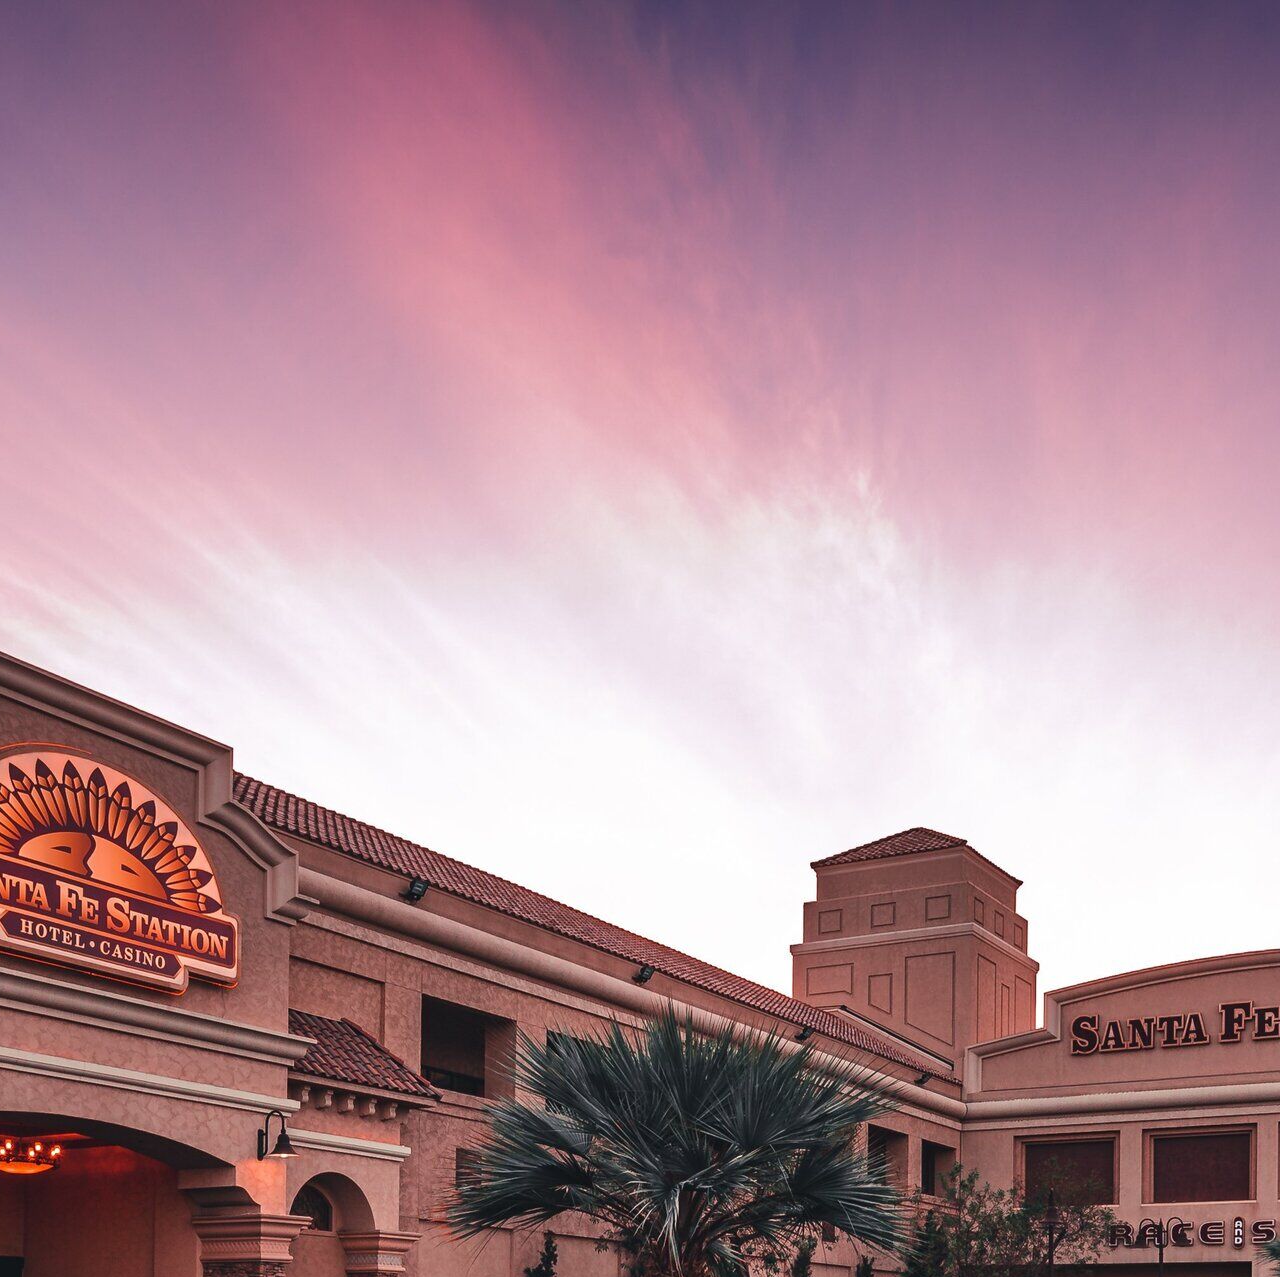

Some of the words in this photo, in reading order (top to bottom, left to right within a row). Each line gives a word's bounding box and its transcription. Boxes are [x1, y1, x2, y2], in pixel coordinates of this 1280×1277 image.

[55, 879, 100, 925] FE
[105, 897, 230, 960] STATION
[19, 918, 86, 949] HOTEL
[99, 940, 167, 971] CASINO
[1071, 1014, 1210, 1056] SANTA
[1107, 1220, 1226, 1248] RACE
